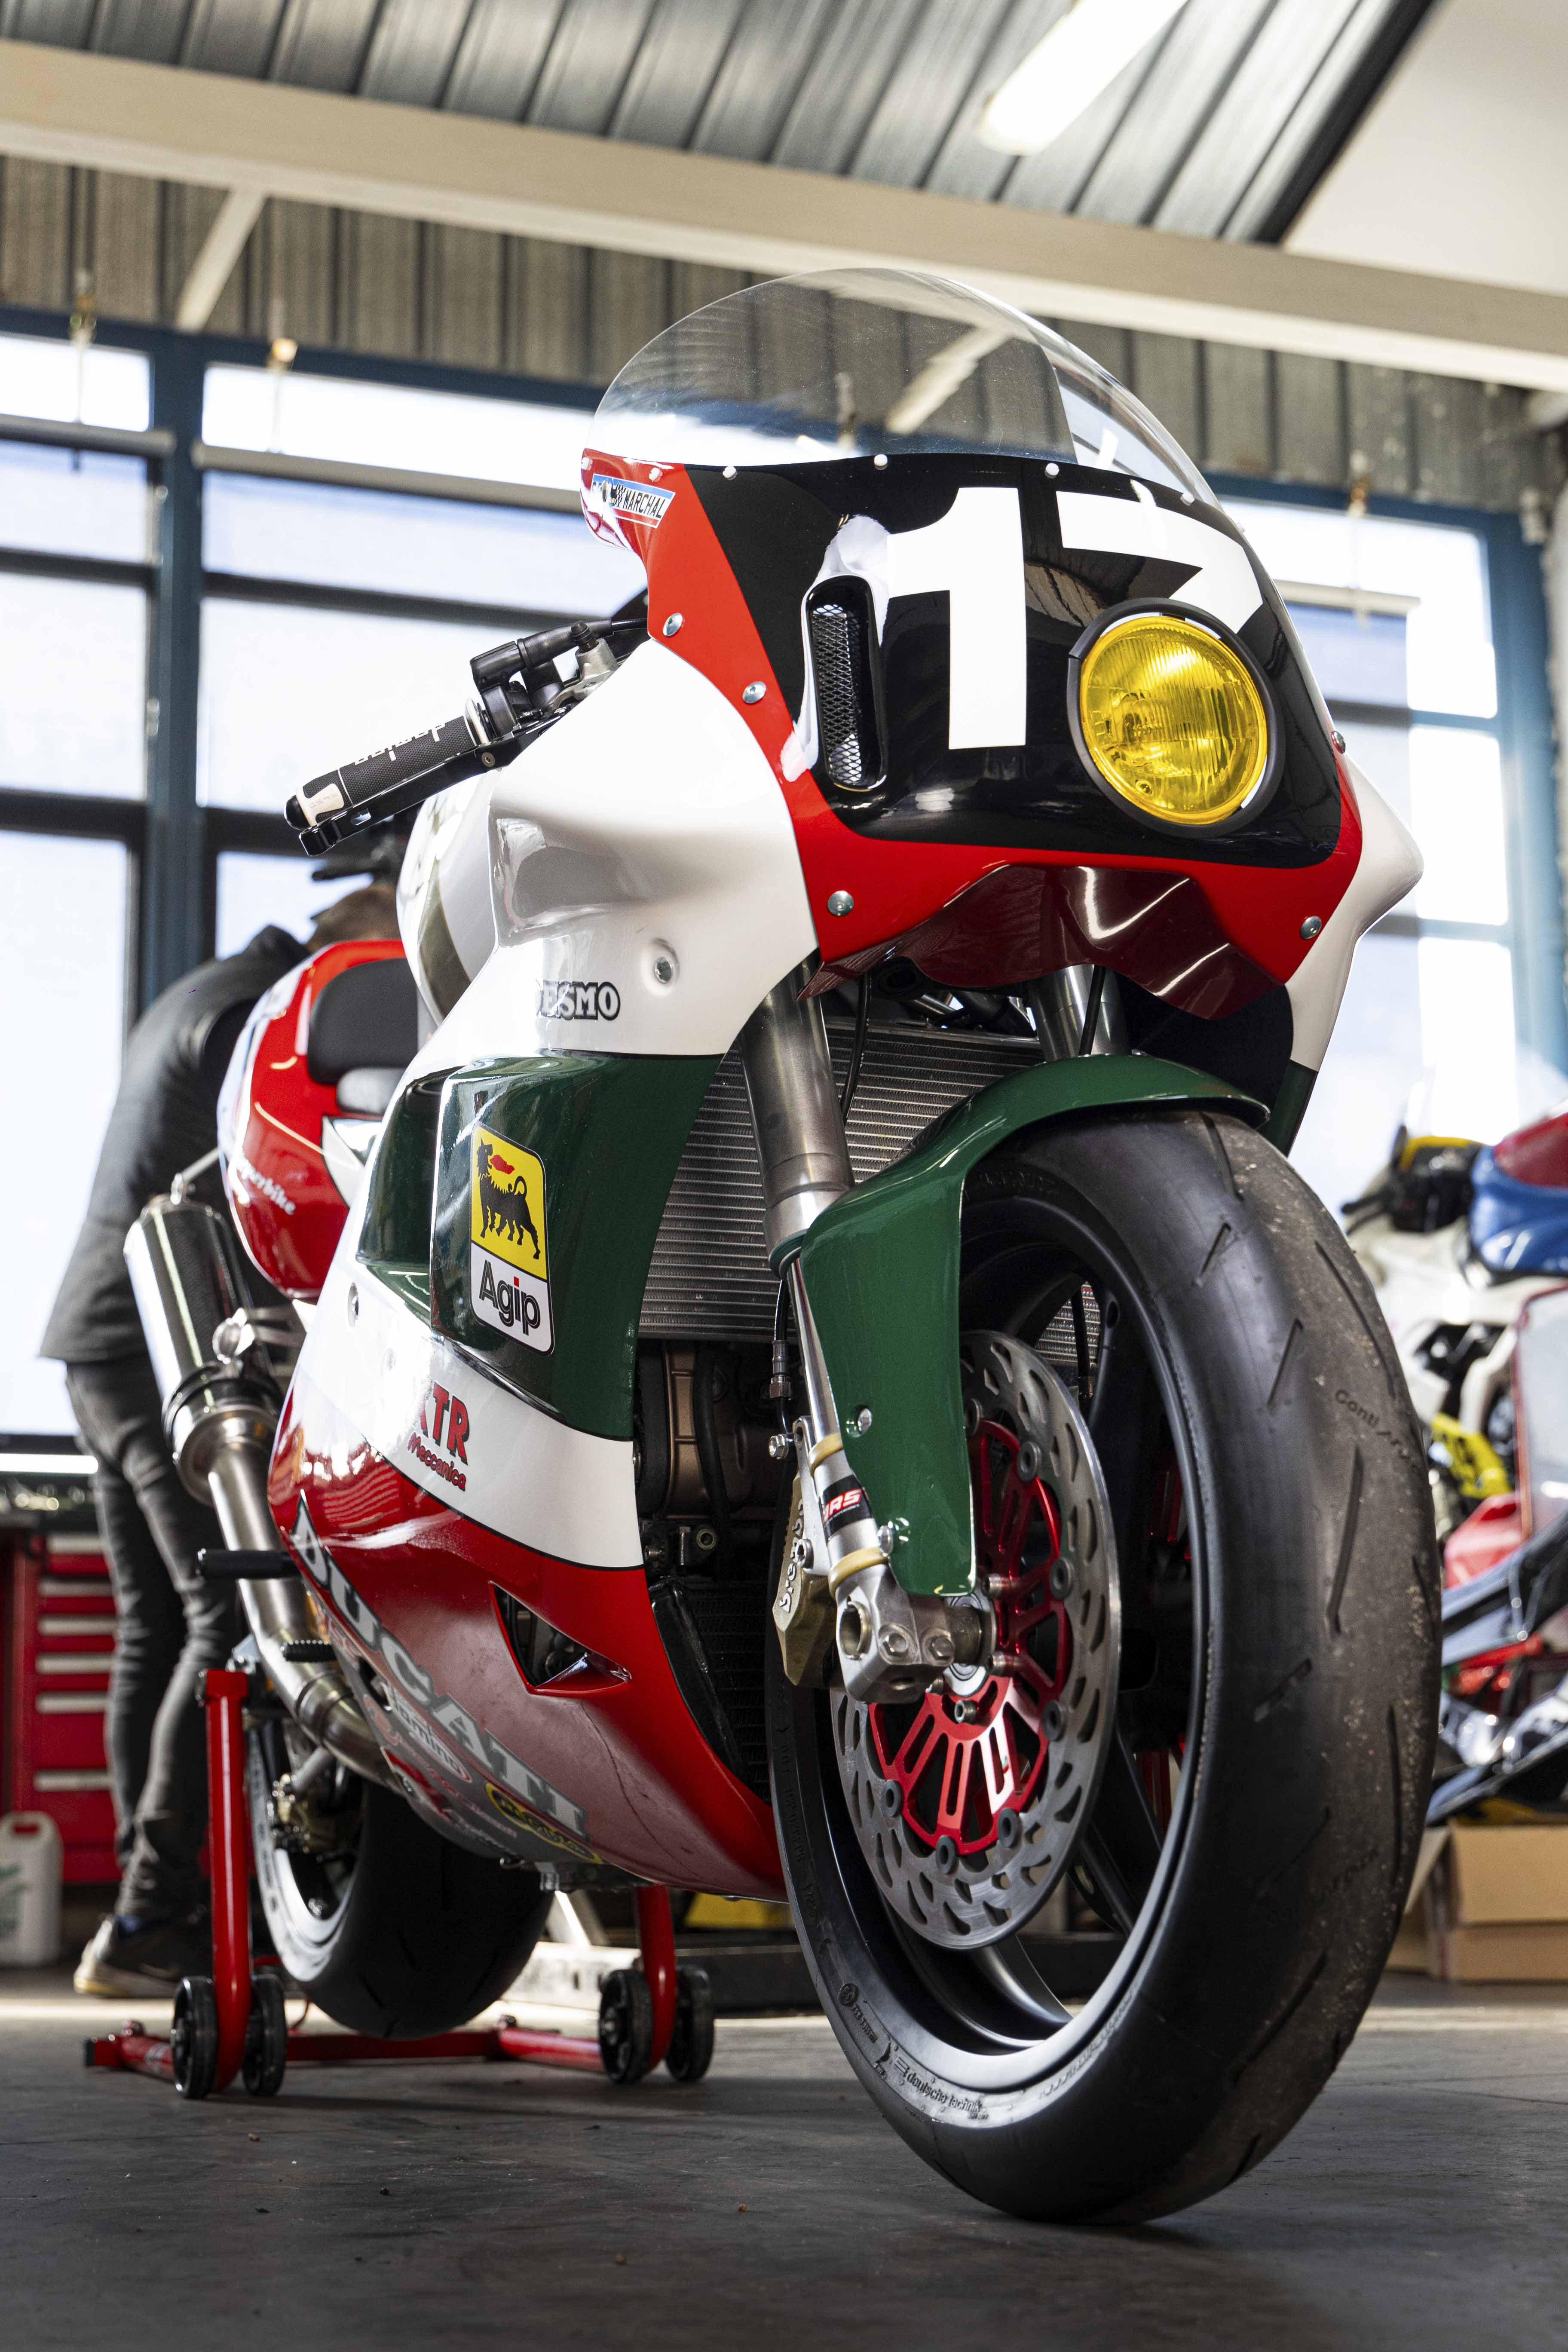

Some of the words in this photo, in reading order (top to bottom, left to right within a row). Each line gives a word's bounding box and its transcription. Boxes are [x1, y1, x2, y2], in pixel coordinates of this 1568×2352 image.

[623, 489, 666, 519] MARCHAL
[479, 1259, 541, 1336] Agip
[407, 1432, 466, 1492] Meccanica
[291, 1495, 591, 1844] DUCATI
